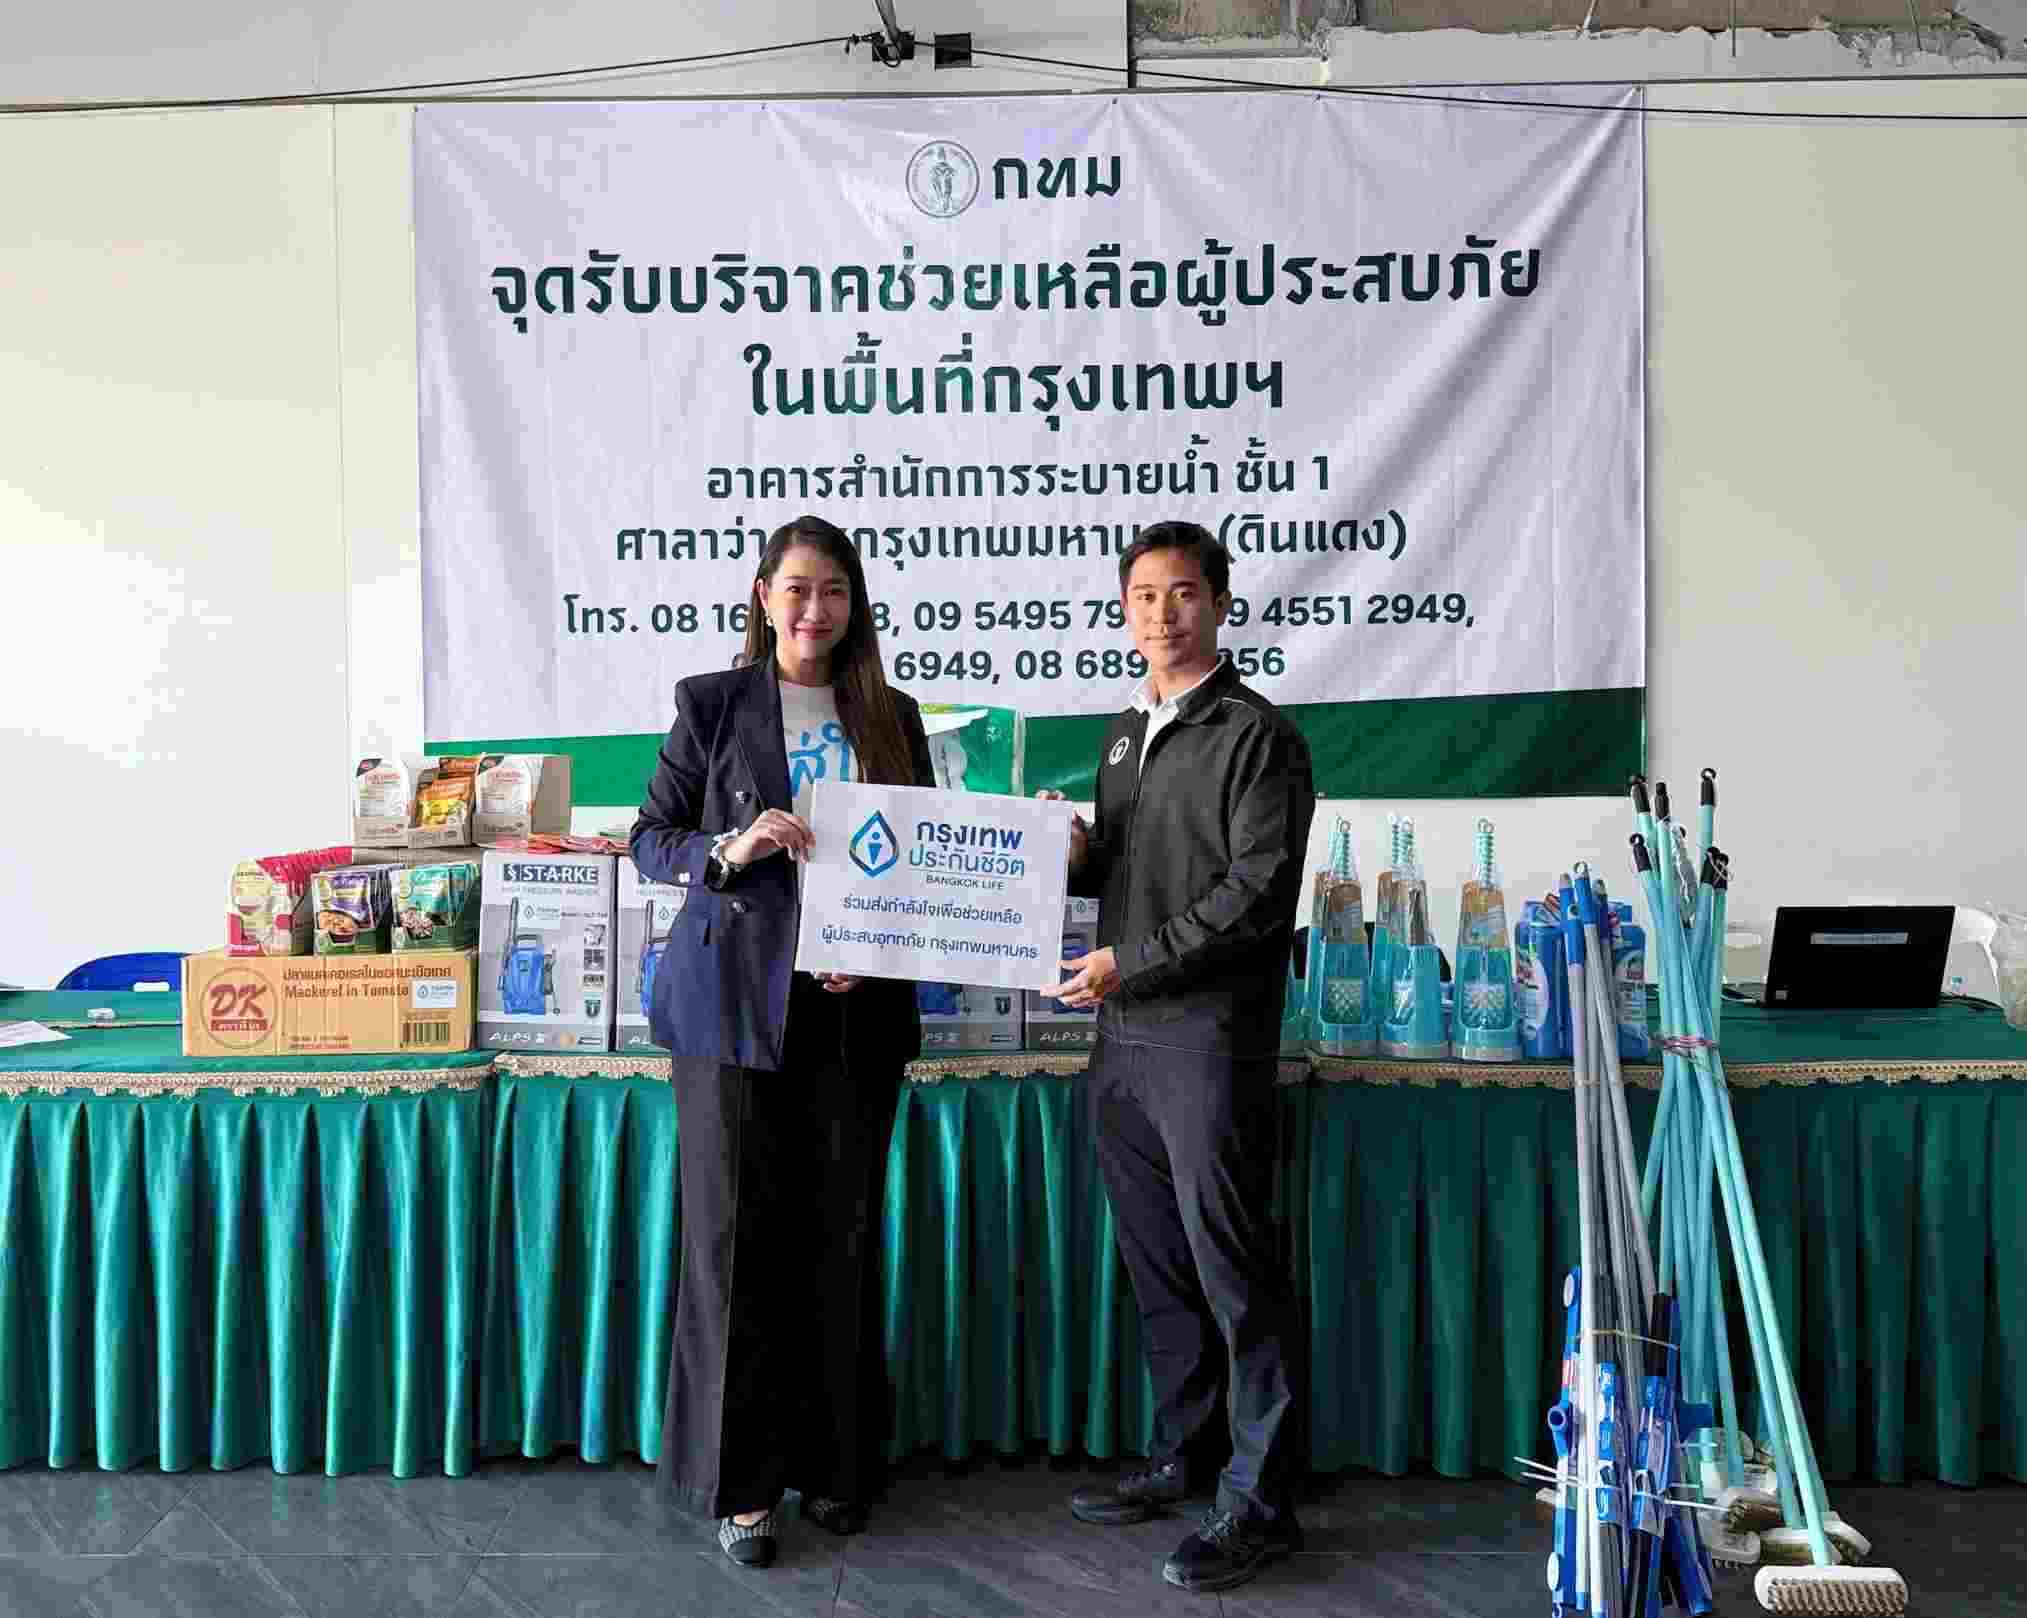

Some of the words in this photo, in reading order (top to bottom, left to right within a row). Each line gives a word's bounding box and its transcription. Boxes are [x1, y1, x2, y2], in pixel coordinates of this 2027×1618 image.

[992, 155, 1121, 200] กทม
[491, 235, 1541, 334] จุดรับบริจาคช่วยเหลือผู้ประสบภัย
[743, 332, 1283, 431] ในพื้นที่กรุงเทพฯ
[707, 434, 1219, 498] อาคารสำนักการระบายน้ำ
[1236, 437, 1295, 493] ชั้น
[1311, 456, 1329, 490] 1
[1219, 510, 1407, 561] (ดินแดง)
[563, 594, 639, 633] โทร.
[651, 603, 699, 633] 08
[711, 603, 747, 633] 16
[914, 602, 962, 632] 09
[975, 600, 1072, 631] 5495
[1083, 600, 1125, 630] 79
[1261, 595, 1352, 627] 4551
[1367, 593, 1474, 627] 2949,
[893, 651, 1001, 685] 6949,
[1015, 650, 1062, 680] 08
[1075, 649, 1149, 680] 689
[917, 820, 1024, 852] กรุงเทพ
[521, 865, 600, 883] STARKE
[908, 845, 1025, 878] ประกันชีวิต
[925, 874, 979, 890] BANGKOK
[980, 876, 1006, 891] LIFE
[209, 984, 268, 1018] DK
